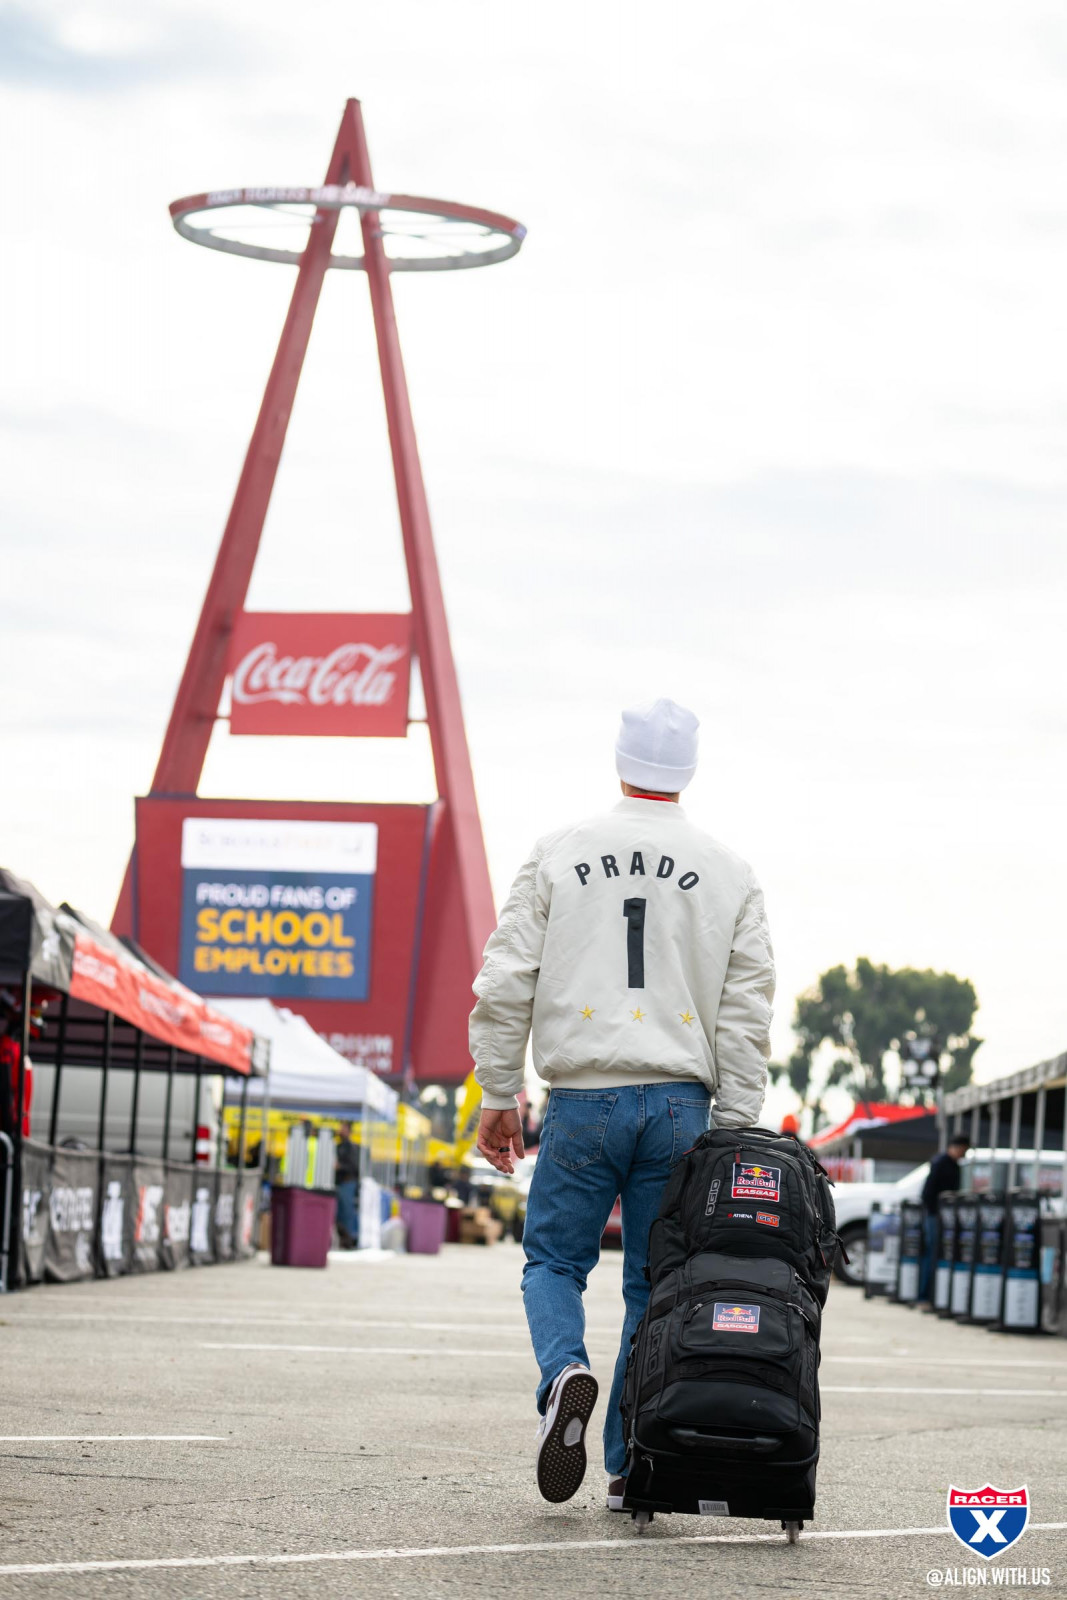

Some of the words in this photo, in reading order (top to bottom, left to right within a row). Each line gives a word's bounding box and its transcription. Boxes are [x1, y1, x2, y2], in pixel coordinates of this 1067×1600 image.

[574, 851, 700, 891] PRADO
[195, 881, 269, 908] PROUD
[271, 884, 323, 910] FANS
[326, 887, 358, 910] OF
[196, 909, 356, 948] SCHOOL
[622, 897, 647, 989] 1
[194, 945, 354, 978] EMPLOYEES
[704, 1178, 721, 1216] OGIO
[736, 1188, 775, 1197] GASGAS
[737, 1176, 756, 1186] Red
[757, 1178, 775, 1188] Bull
[718, 1314, 736, 1322] Red
[737, 1315, 755, 1323] Bull
